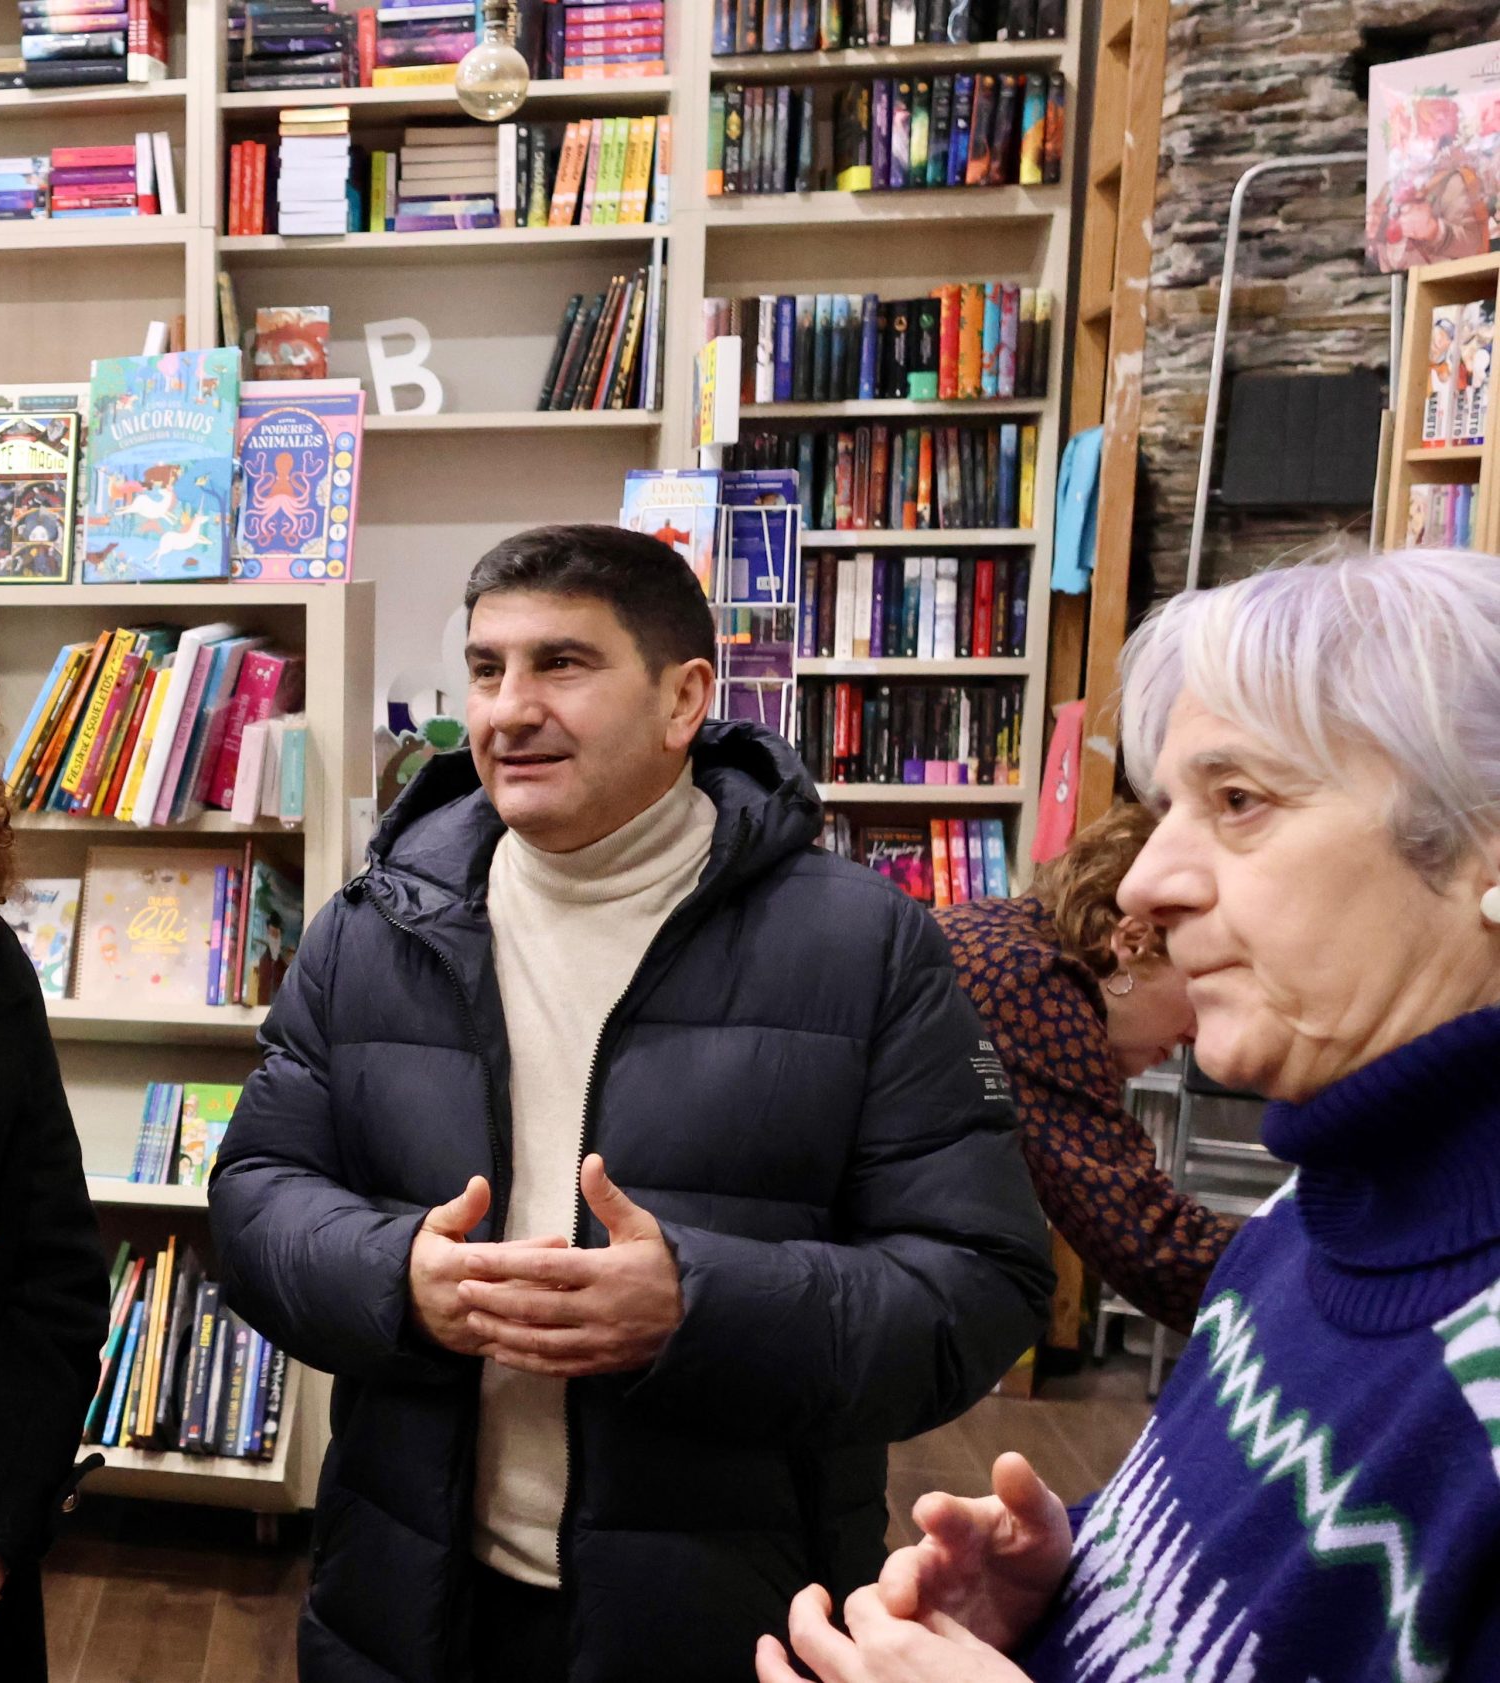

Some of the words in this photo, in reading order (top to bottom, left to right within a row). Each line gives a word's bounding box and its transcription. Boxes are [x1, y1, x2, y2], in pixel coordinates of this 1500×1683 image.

[364, 317, 444, 416] B
[111, 409, 215, 441] UNICORNIOS
[261, 424, 313, 435] PODERES
[1426, 392, 1437, 438] NARUTO
[248, 435, 324, 449] ANIMALES
[652, 481, 705, 494] DIVINA
[67, 752, 85, 784] FIESTA
[85, 674, 114, 744] ESQUELETOS
[866, 841, 925, 868] Keeping
[199, 1314, 213, 1347] ESPACIO
